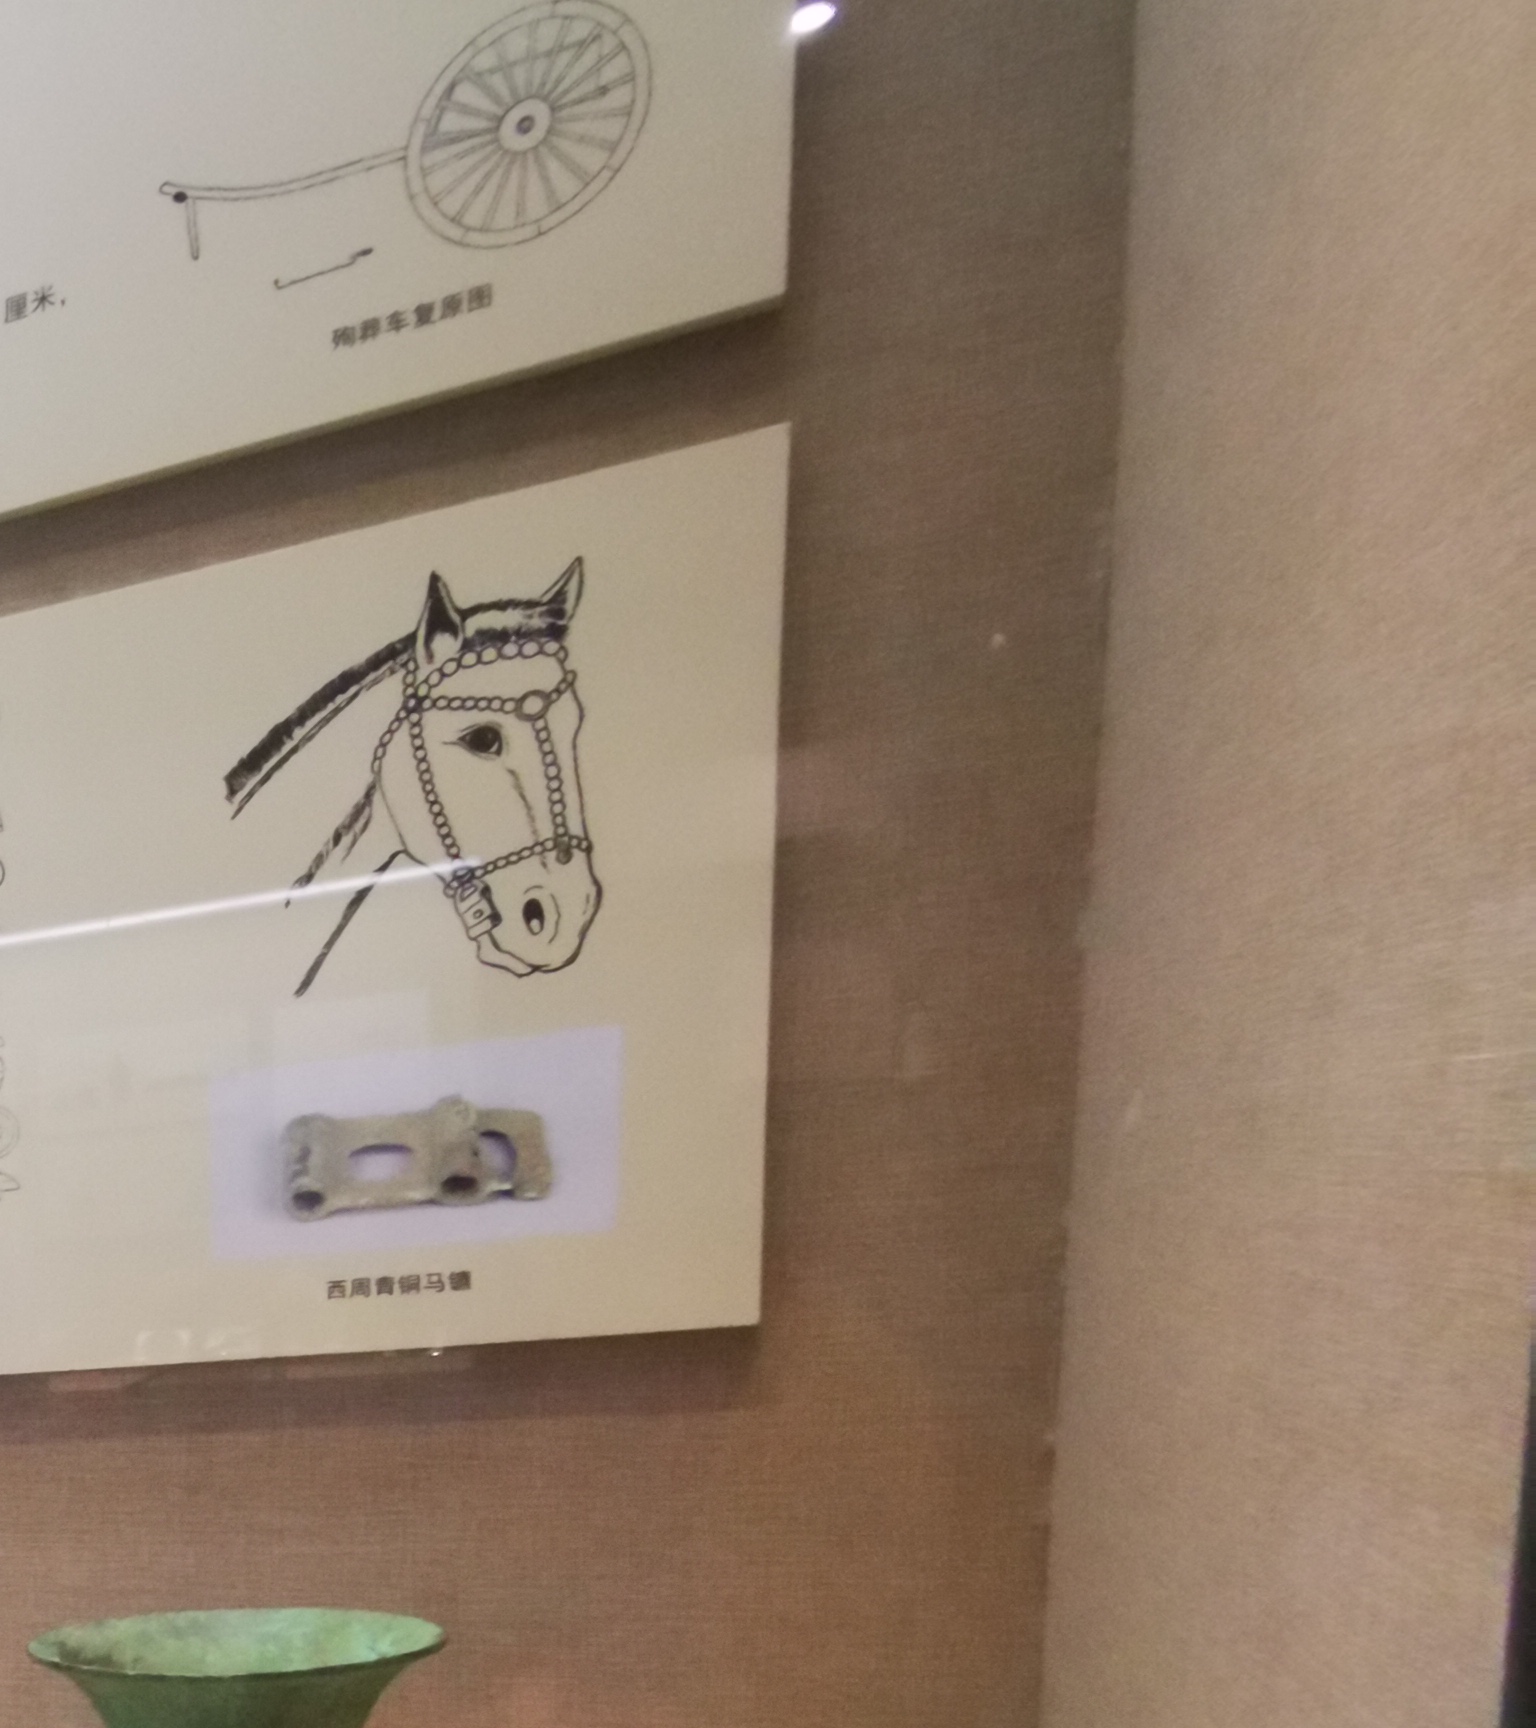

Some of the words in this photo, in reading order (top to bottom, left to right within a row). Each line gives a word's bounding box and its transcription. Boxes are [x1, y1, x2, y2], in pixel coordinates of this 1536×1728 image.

[331, 284, 494, 351] 殉葬车复原图
